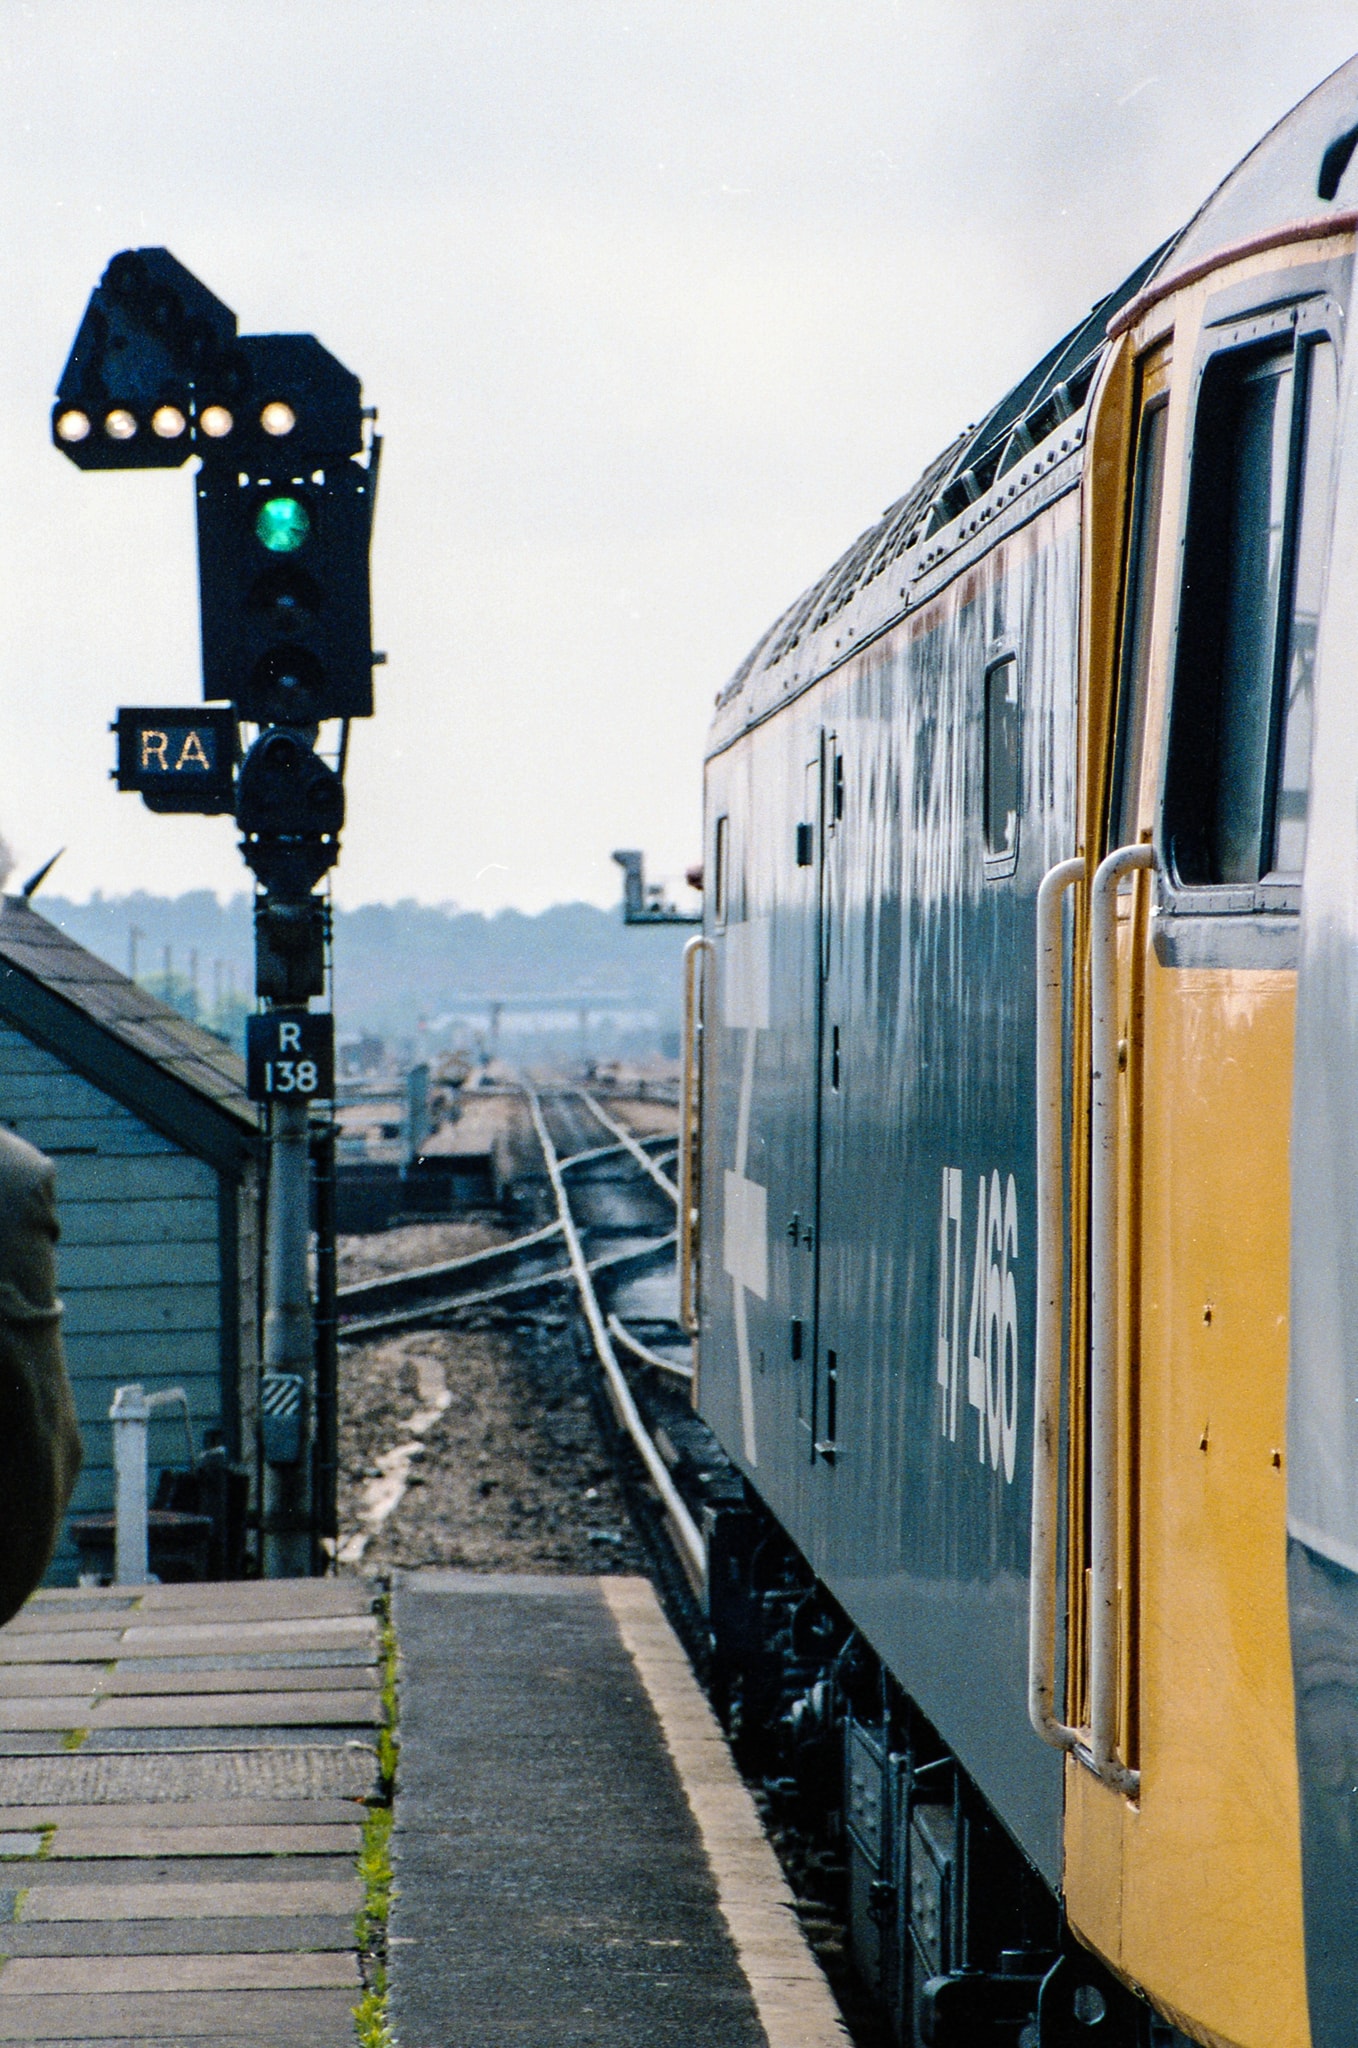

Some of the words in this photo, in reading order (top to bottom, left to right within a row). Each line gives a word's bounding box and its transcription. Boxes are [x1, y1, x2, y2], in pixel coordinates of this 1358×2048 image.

[141, 730, 210, 771] RA
[279, 1022, 301, 1052] R
[264, 1061, 319, 1093] 138
